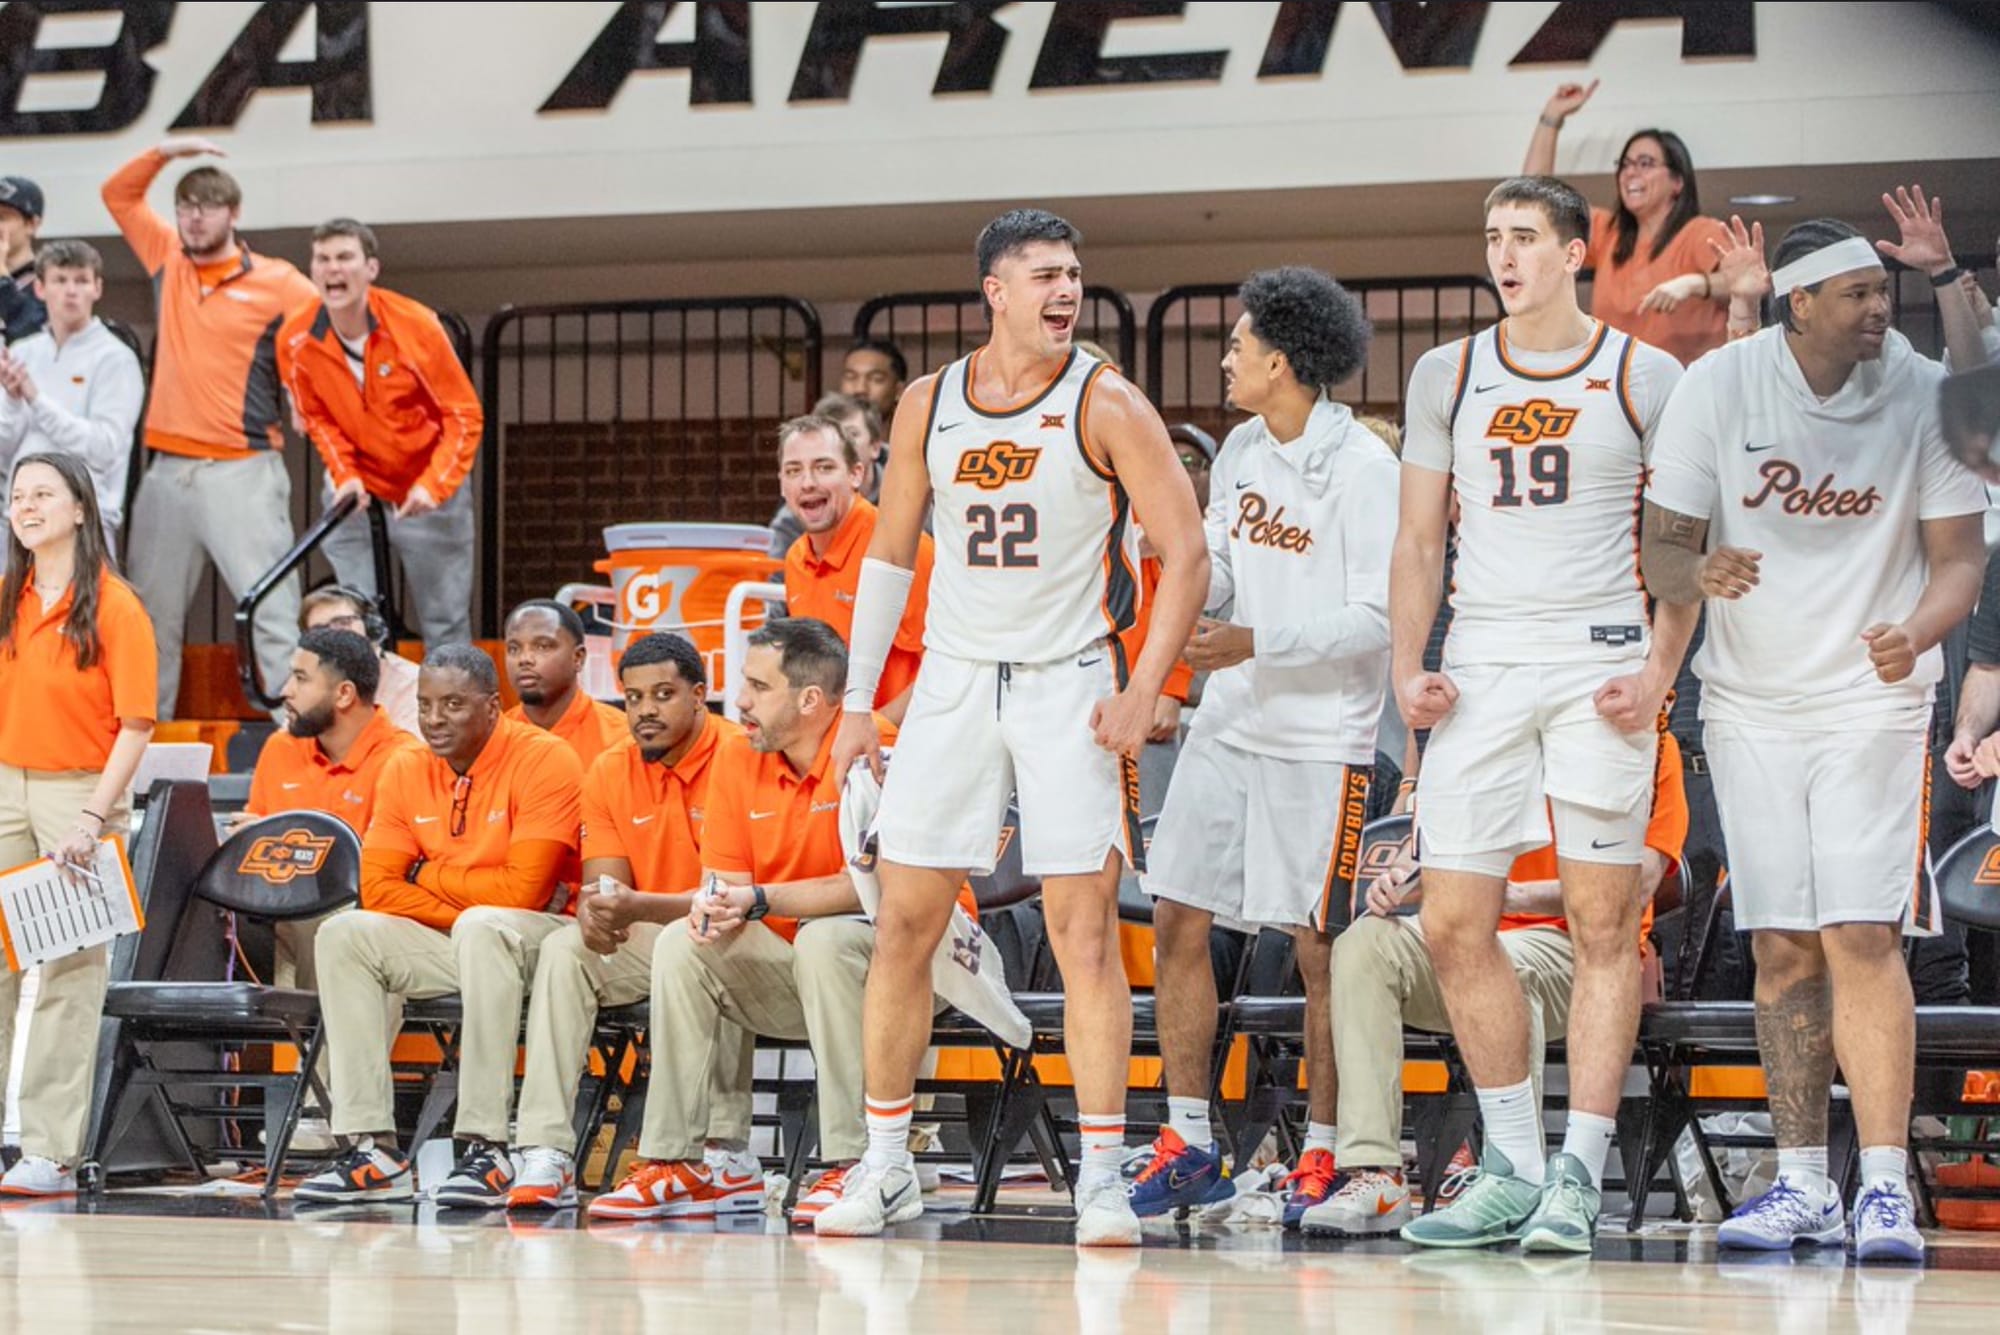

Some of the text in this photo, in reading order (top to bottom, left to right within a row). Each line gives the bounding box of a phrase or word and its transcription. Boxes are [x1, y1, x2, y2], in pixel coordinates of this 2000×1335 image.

[1483, 397, 1582, 445] OSU
[953, 440, 1043, 491] OSU
[1489, 444, 1569, 507] 19
[1742, 459, 1882, 517] Pokes
[965, 503, 1039, 568] 22
[1231, 492, 1314, 553] Pokes
[627, 573, 660, 619] G
[1338, 772, 1369, 881] COWBOYS
